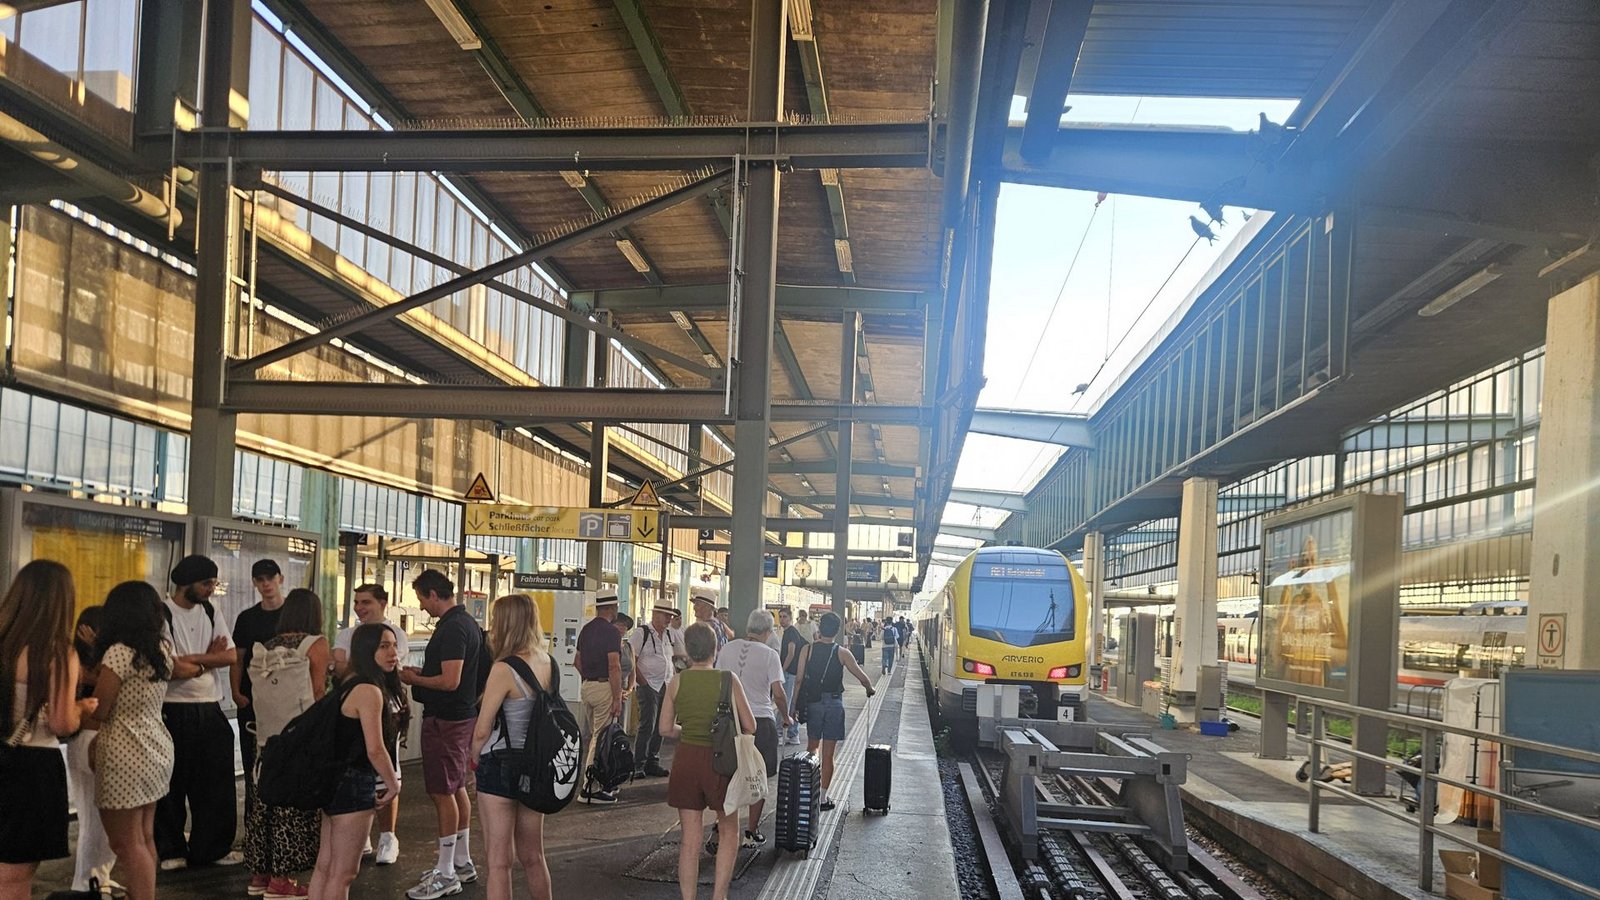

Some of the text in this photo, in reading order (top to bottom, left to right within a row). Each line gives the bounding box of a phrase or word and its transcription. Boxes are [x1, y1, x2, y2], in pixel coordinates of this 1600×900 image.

[488, 522, 551, 533] Schließfächer
[587, 519, 598, 536] P
[702, 528, 709, 538] 3
[359, 532, 366, 543] 2
[520, 575, 559, 584] Fahrkarten
[1001, 655, 1045, 664] ARVERIO
[1062, 708, 1069, 720] 4
